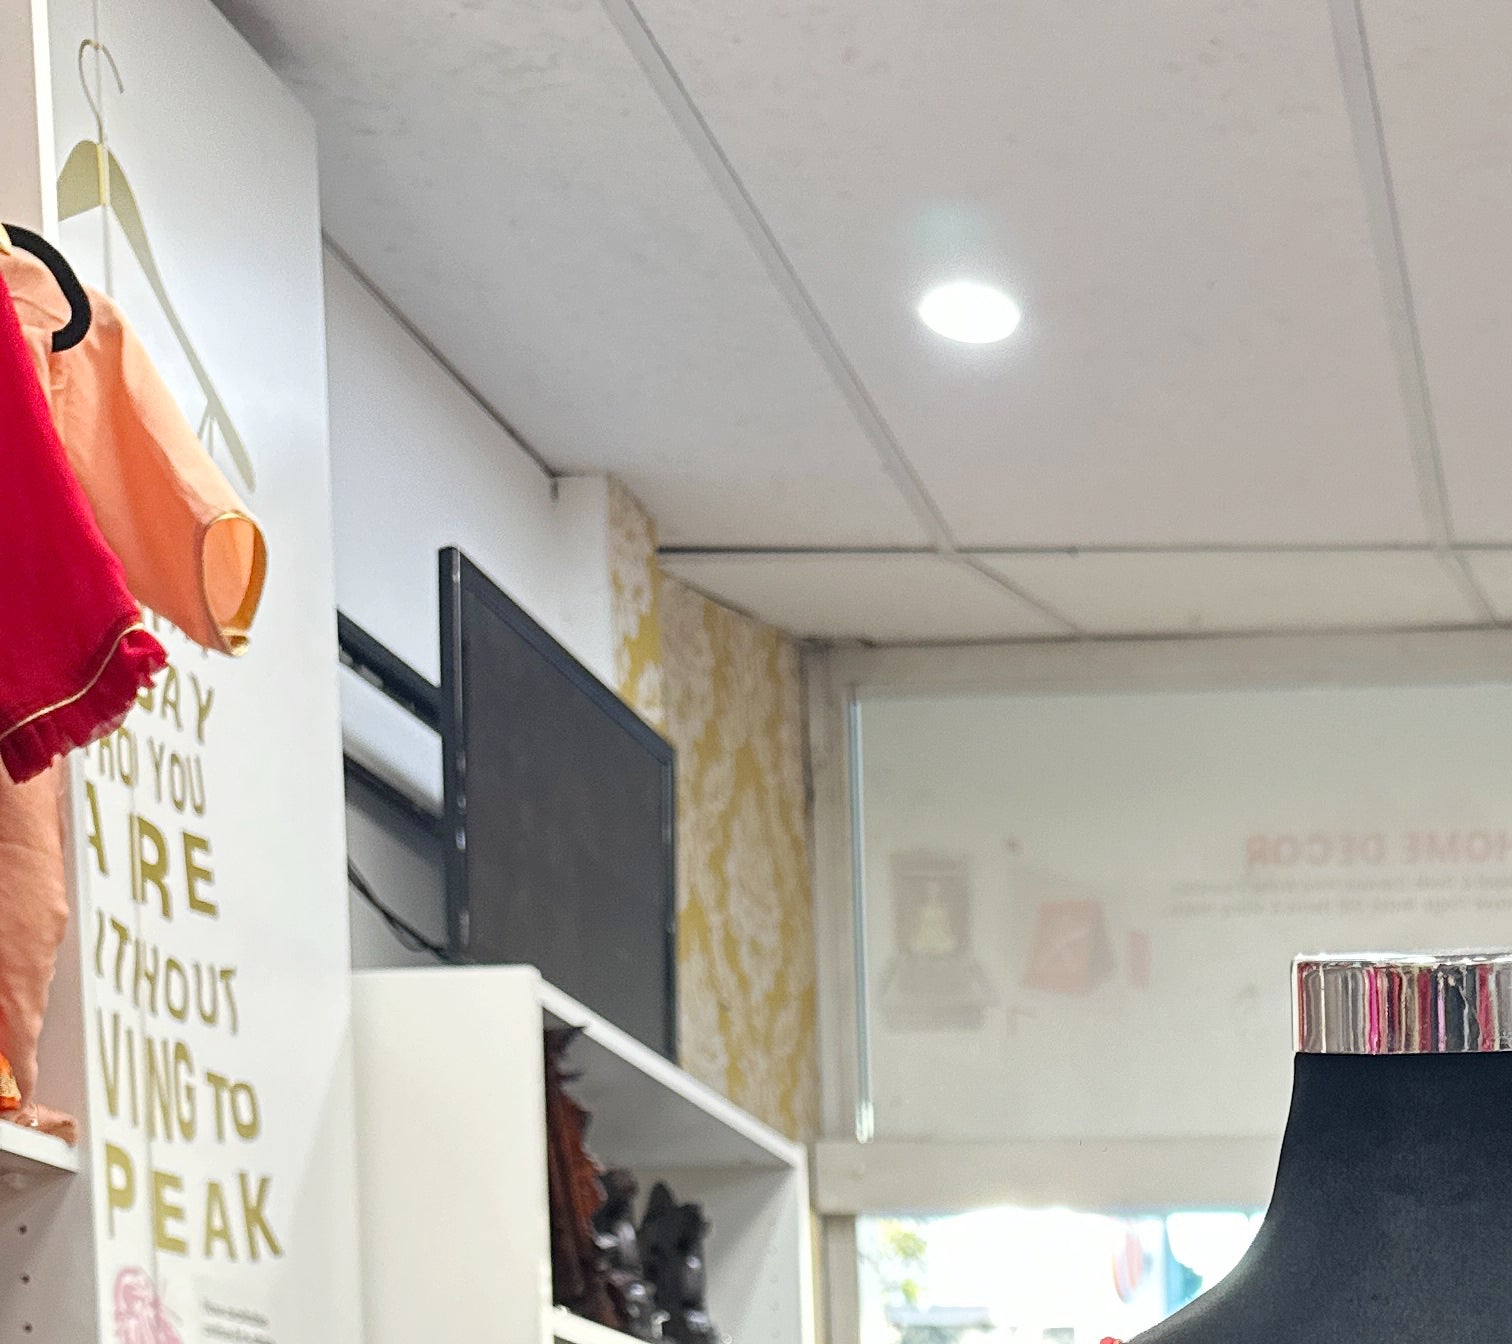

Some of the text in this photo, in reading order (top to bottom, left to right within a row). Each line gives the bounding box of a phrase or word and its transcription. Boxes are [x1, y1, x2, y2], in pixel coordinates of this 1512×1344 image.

[86, 727, 206, 815] HO YOU
[205, 1069, 261, 1143] TO
